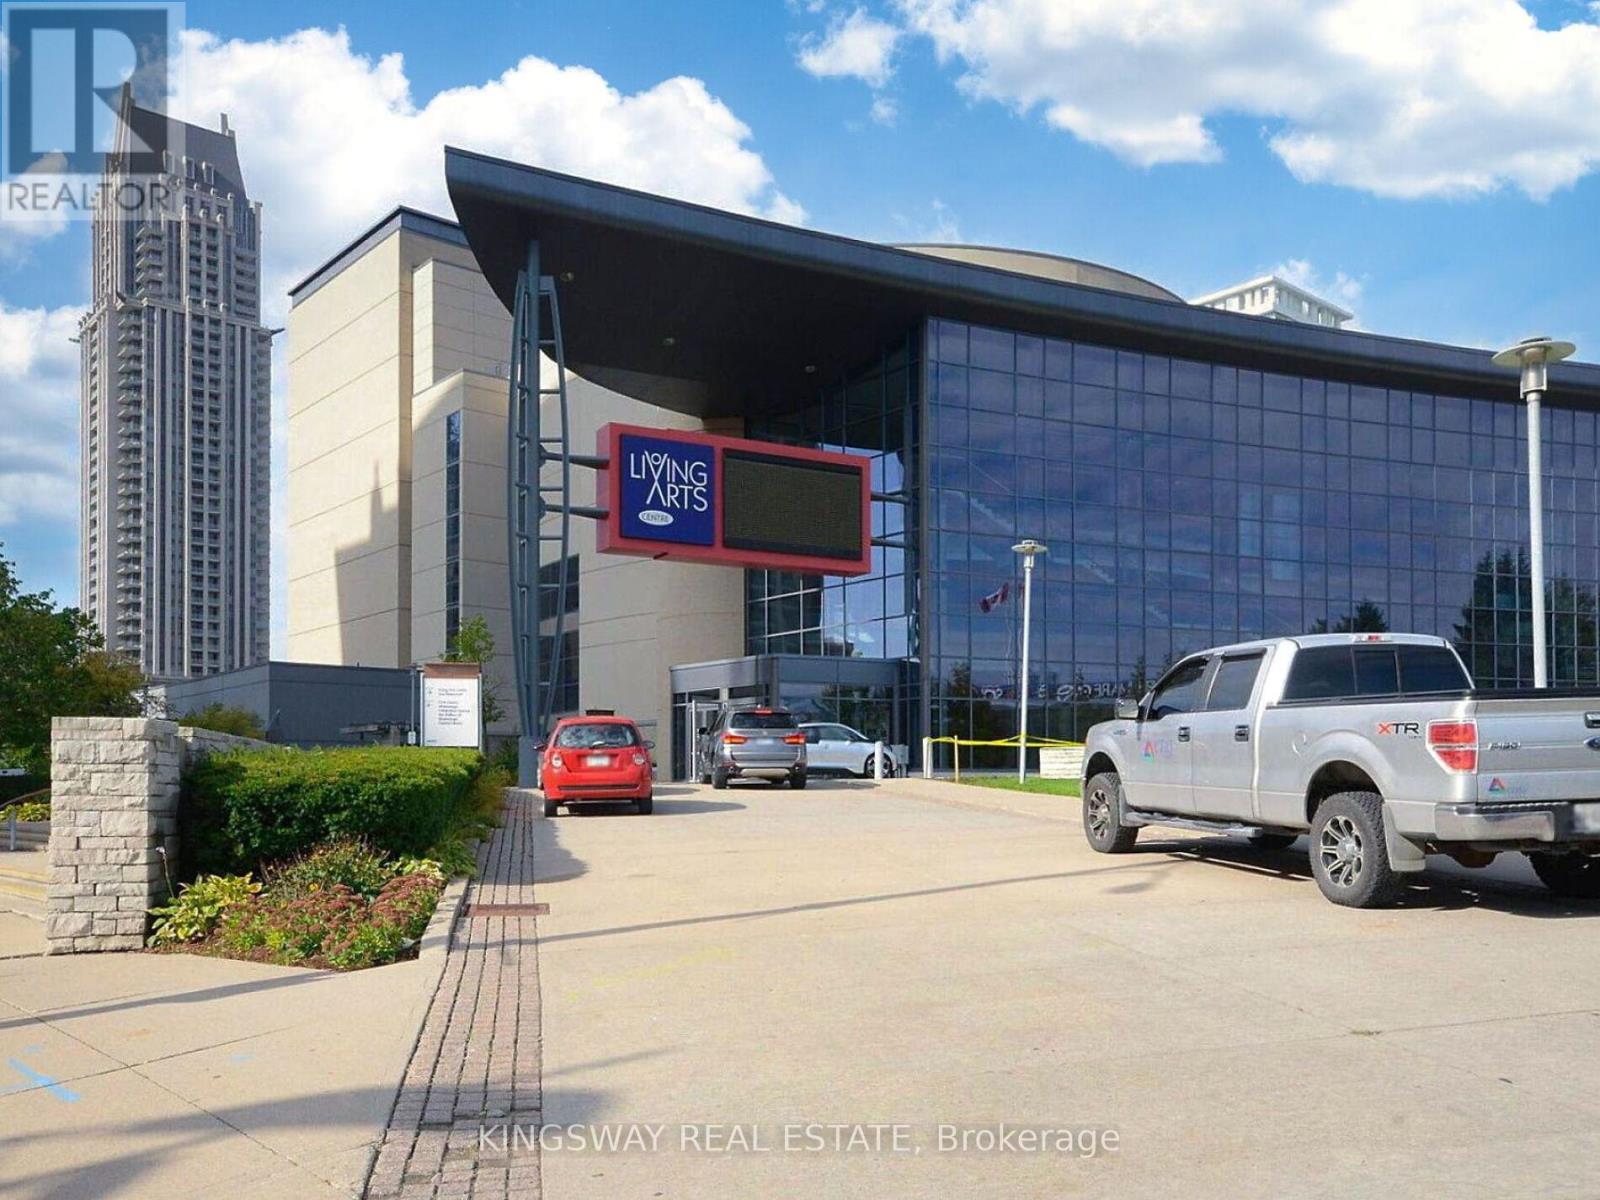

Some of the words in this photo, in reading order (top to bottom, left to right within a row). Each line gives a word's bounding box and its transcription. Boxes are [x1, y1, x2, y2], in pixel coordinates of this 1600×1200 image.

[630, 450, 707, 486] LIVING
[646, 479, 708, 512] ARTS
[1378, 722, 1419, 735] XTR
